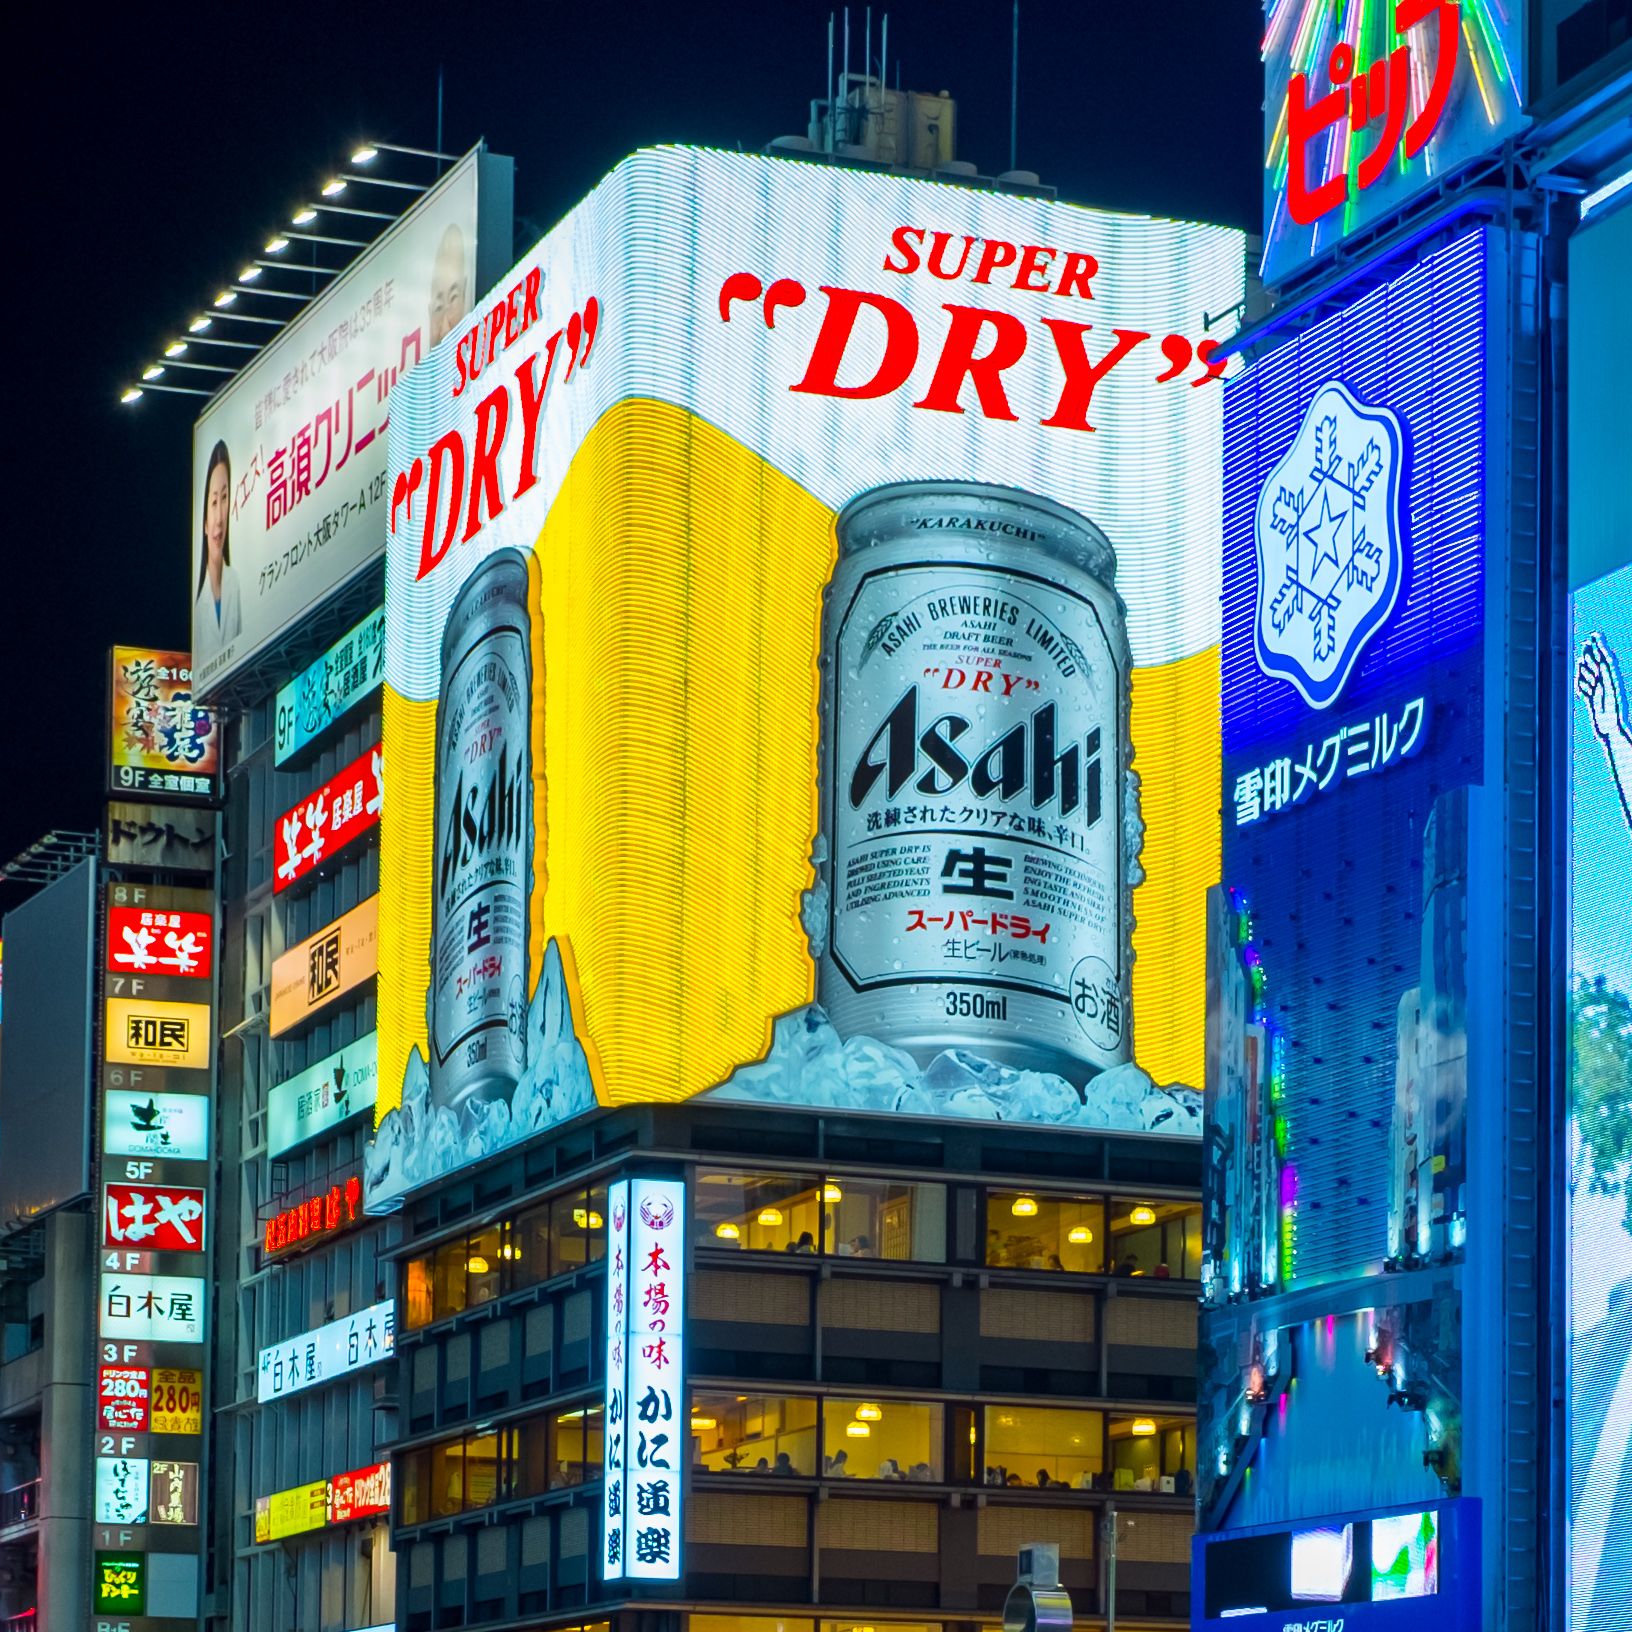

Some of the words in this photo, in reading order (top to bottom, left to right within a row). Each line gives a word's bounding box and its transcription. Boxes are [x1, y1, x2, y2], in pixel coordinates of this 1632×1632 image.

[883, 225, 1098, 300] SUPER
[452, 266, 542, 397] SUPER
[881, 612, 922, 656] ASAHI
[928, 596, 1019, 626] BREWERIES
[1026, 618, 1076, 678] LIMITED
[956, 655, 1002, 669] SUPER
[279, 706, 293, 750] 9F
[850, 682, 1101, 829] Asahi
[1234, 697, 1427, 828] 雪印メグミルク
[120, 766, 146, 787] 9F
[111, 818, 215, 848] ドウトン
[441, 740, 522, 899] Asahi
[941, 847, 1014, 901] 生
[115, 887, 146, 904] 8F
[905, 910, 1050, 944] スーパードライ
[112, 978, 144, 995] 7F
[946, 992, 1007, 1021] 350ml
[130, 1020, 186, 1047] 和民
[110, 1070, 143, 1087] 6F
[126, 1161, 153, 1179] 5F
[105, 1252, 140, 1270] 4F
[108, 1285, 196, 1322] 白木屋
[642, 1241, 669, 1371] 本場の味
[103, 1344, 137, 1363] 3F
[102, 1379, 148, 1398] 280円
[152, 1385, 201, 1413] 280円
[101, 1437, 135, 1455] 2F
[636, 1386, 671, 1564] かに道楽
[101, 1529, 133, 1546] 1F
